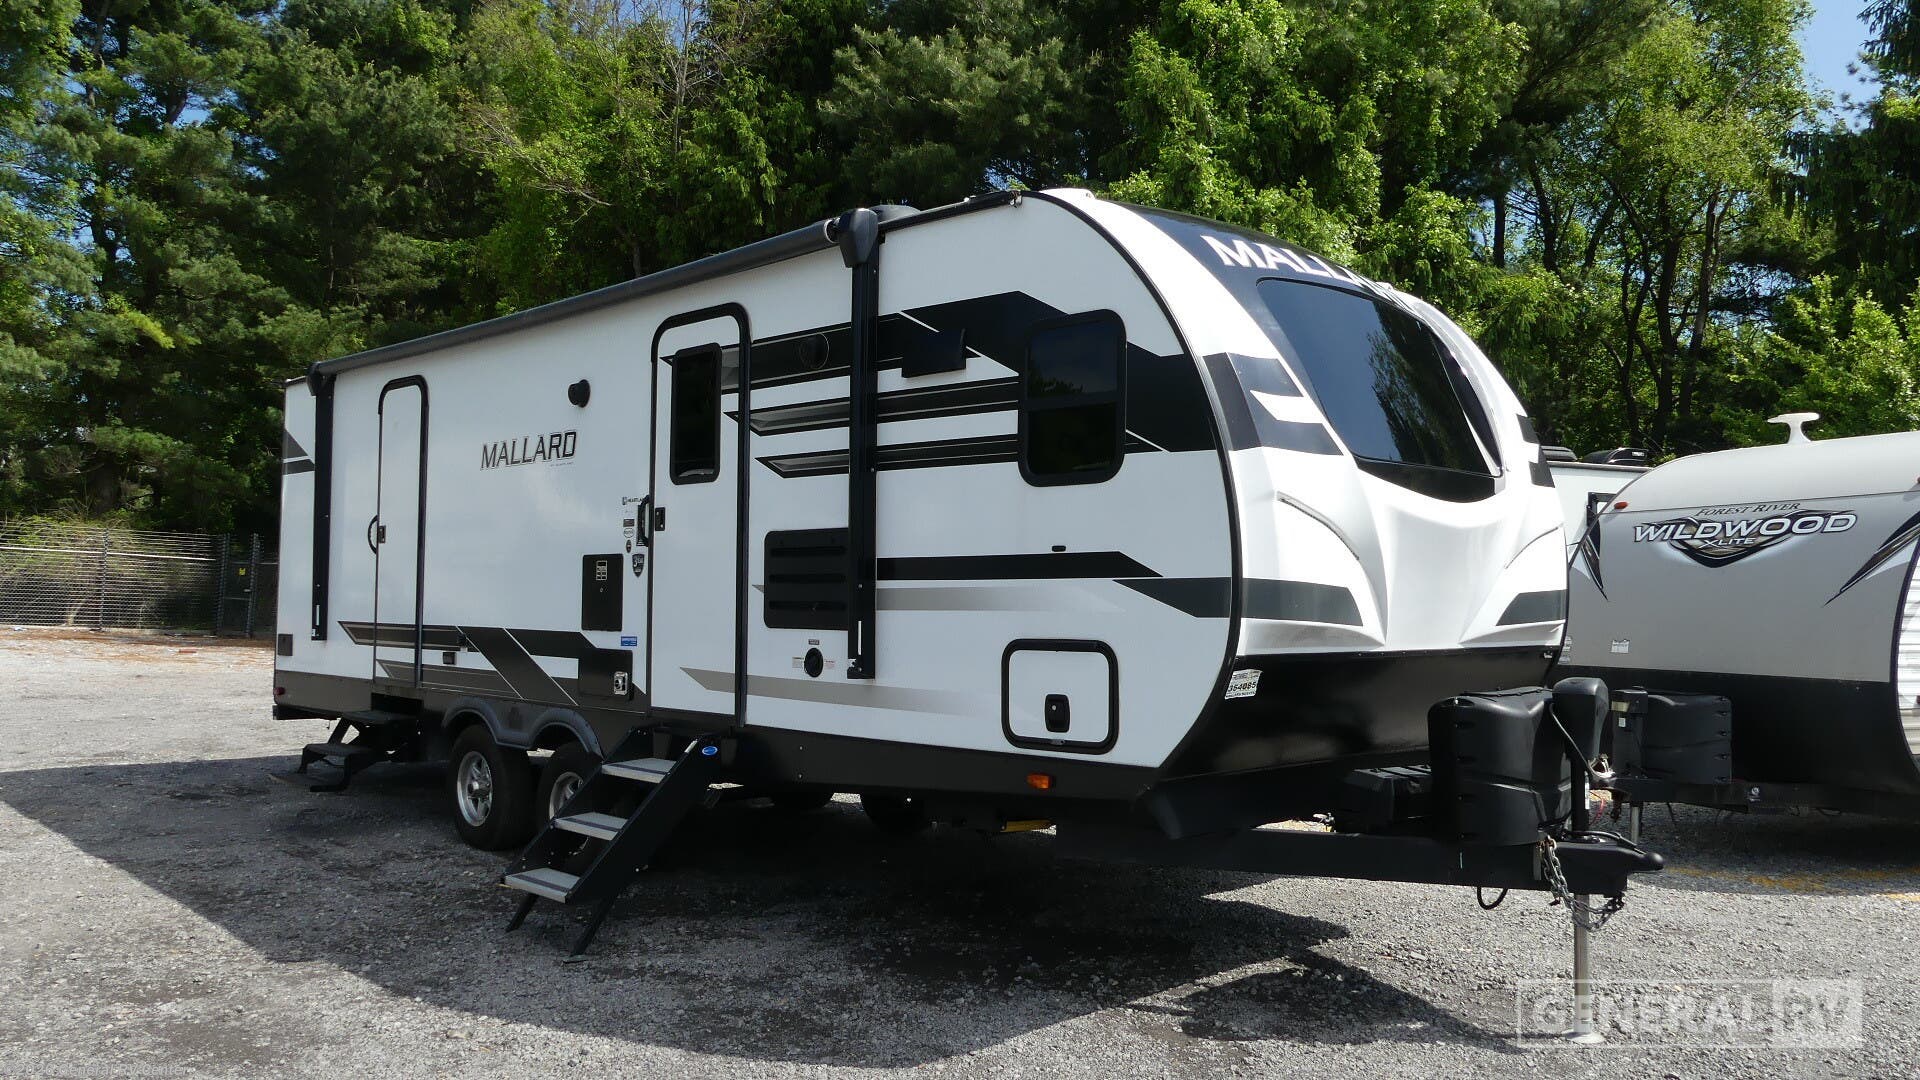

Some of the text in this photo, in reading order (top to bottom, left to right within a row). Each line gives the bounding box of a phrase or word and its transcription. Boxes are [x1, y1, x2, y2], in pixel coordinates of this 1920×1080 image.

[1200, 234, 1392, 302] MALL
[480, 429, 577, 470] MALLARD
[1695, 502, 1801, 517] FOREST RIVER
[1634, 514, 1858, 543] WILDWOOD
